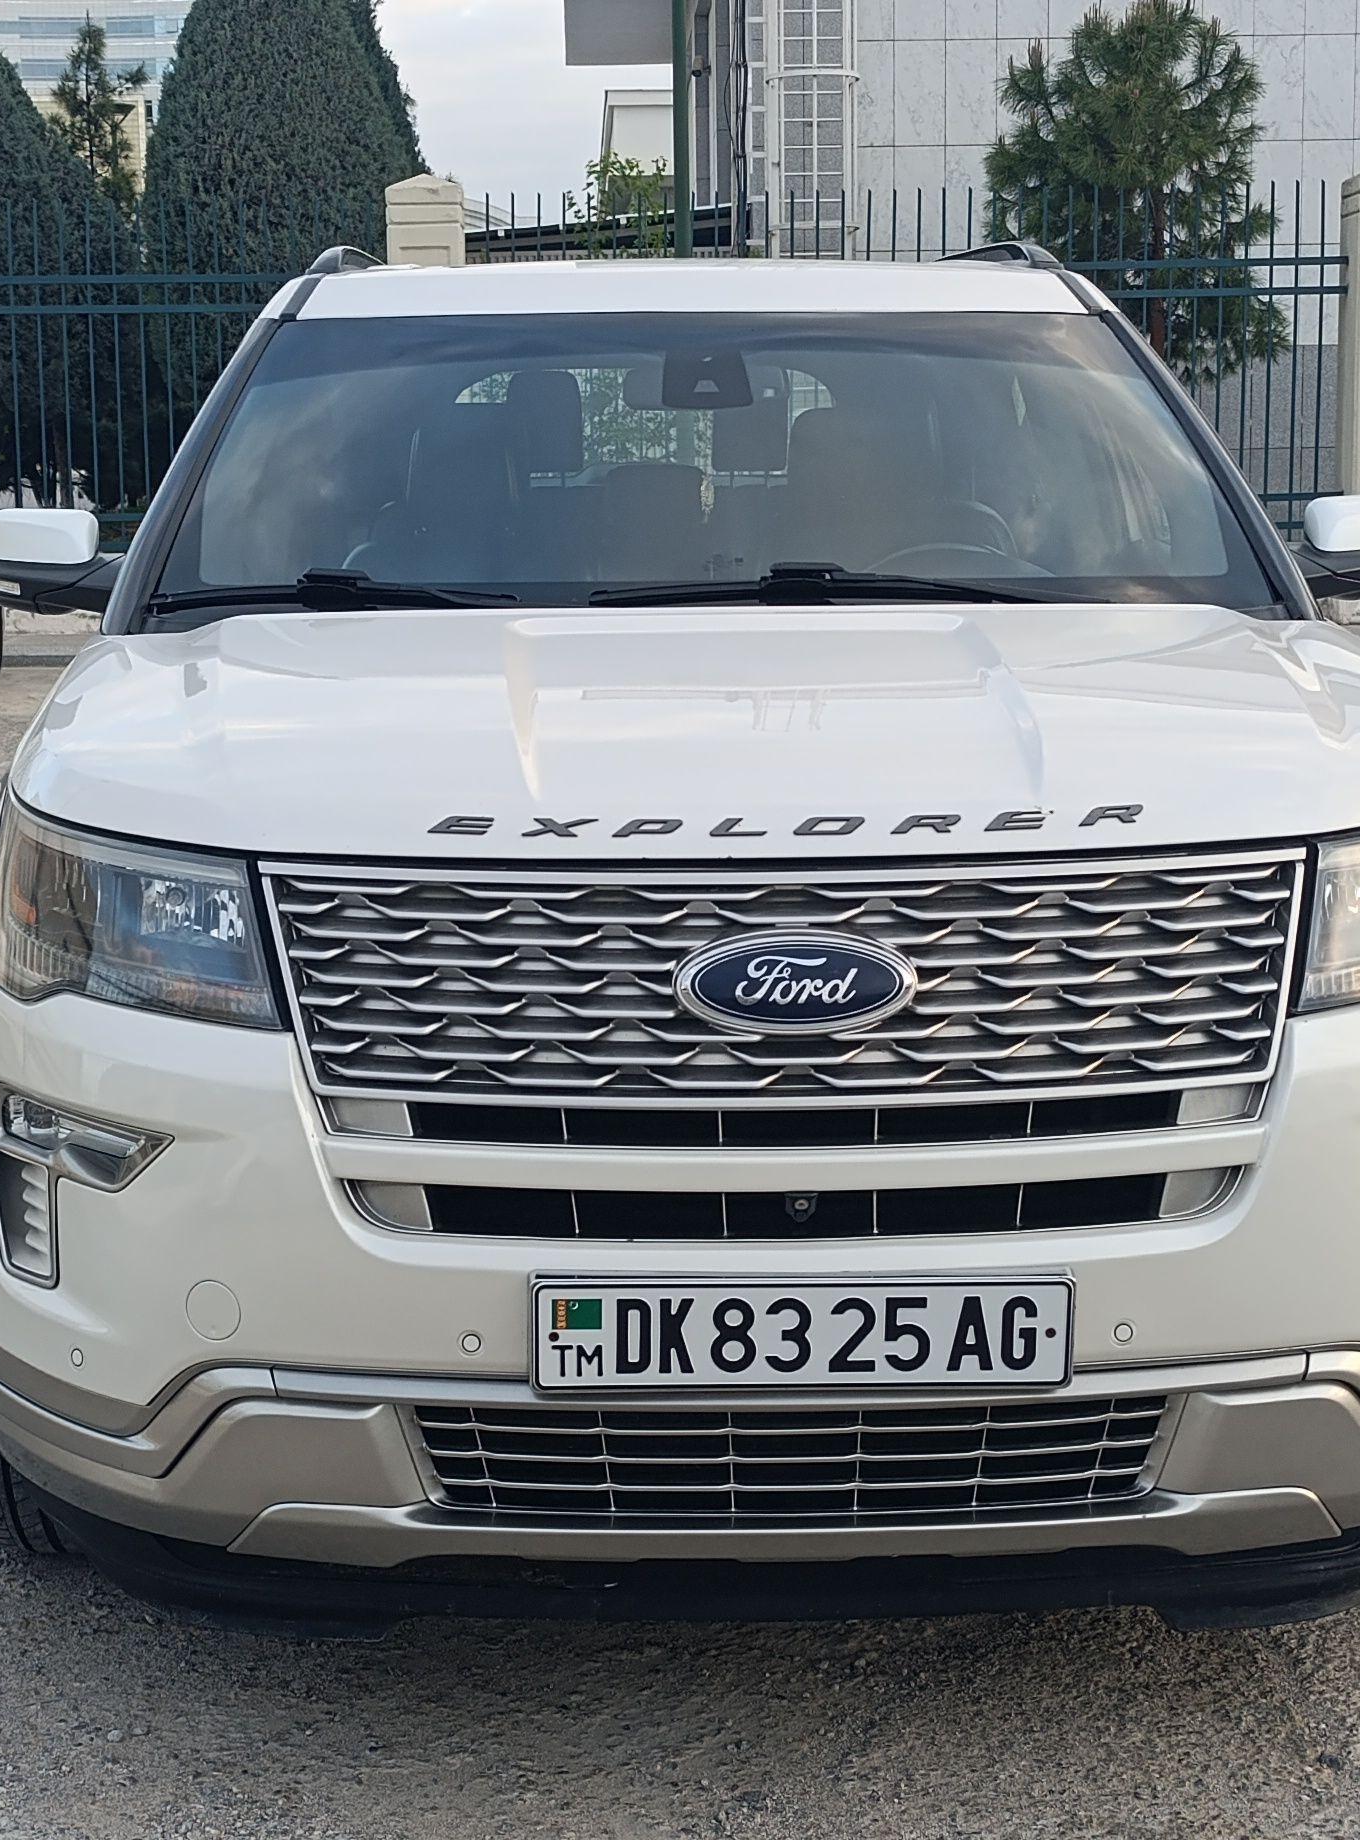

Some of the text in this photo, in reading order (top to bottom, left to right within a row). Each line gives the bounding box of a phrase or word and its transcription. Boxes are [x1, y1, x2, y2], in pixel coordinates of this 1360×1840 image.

[427, 803, 1144, 838] EXPLORER
[735, 955, 857, 1005] Ford
[551, 1344, 603, 1377] TM
